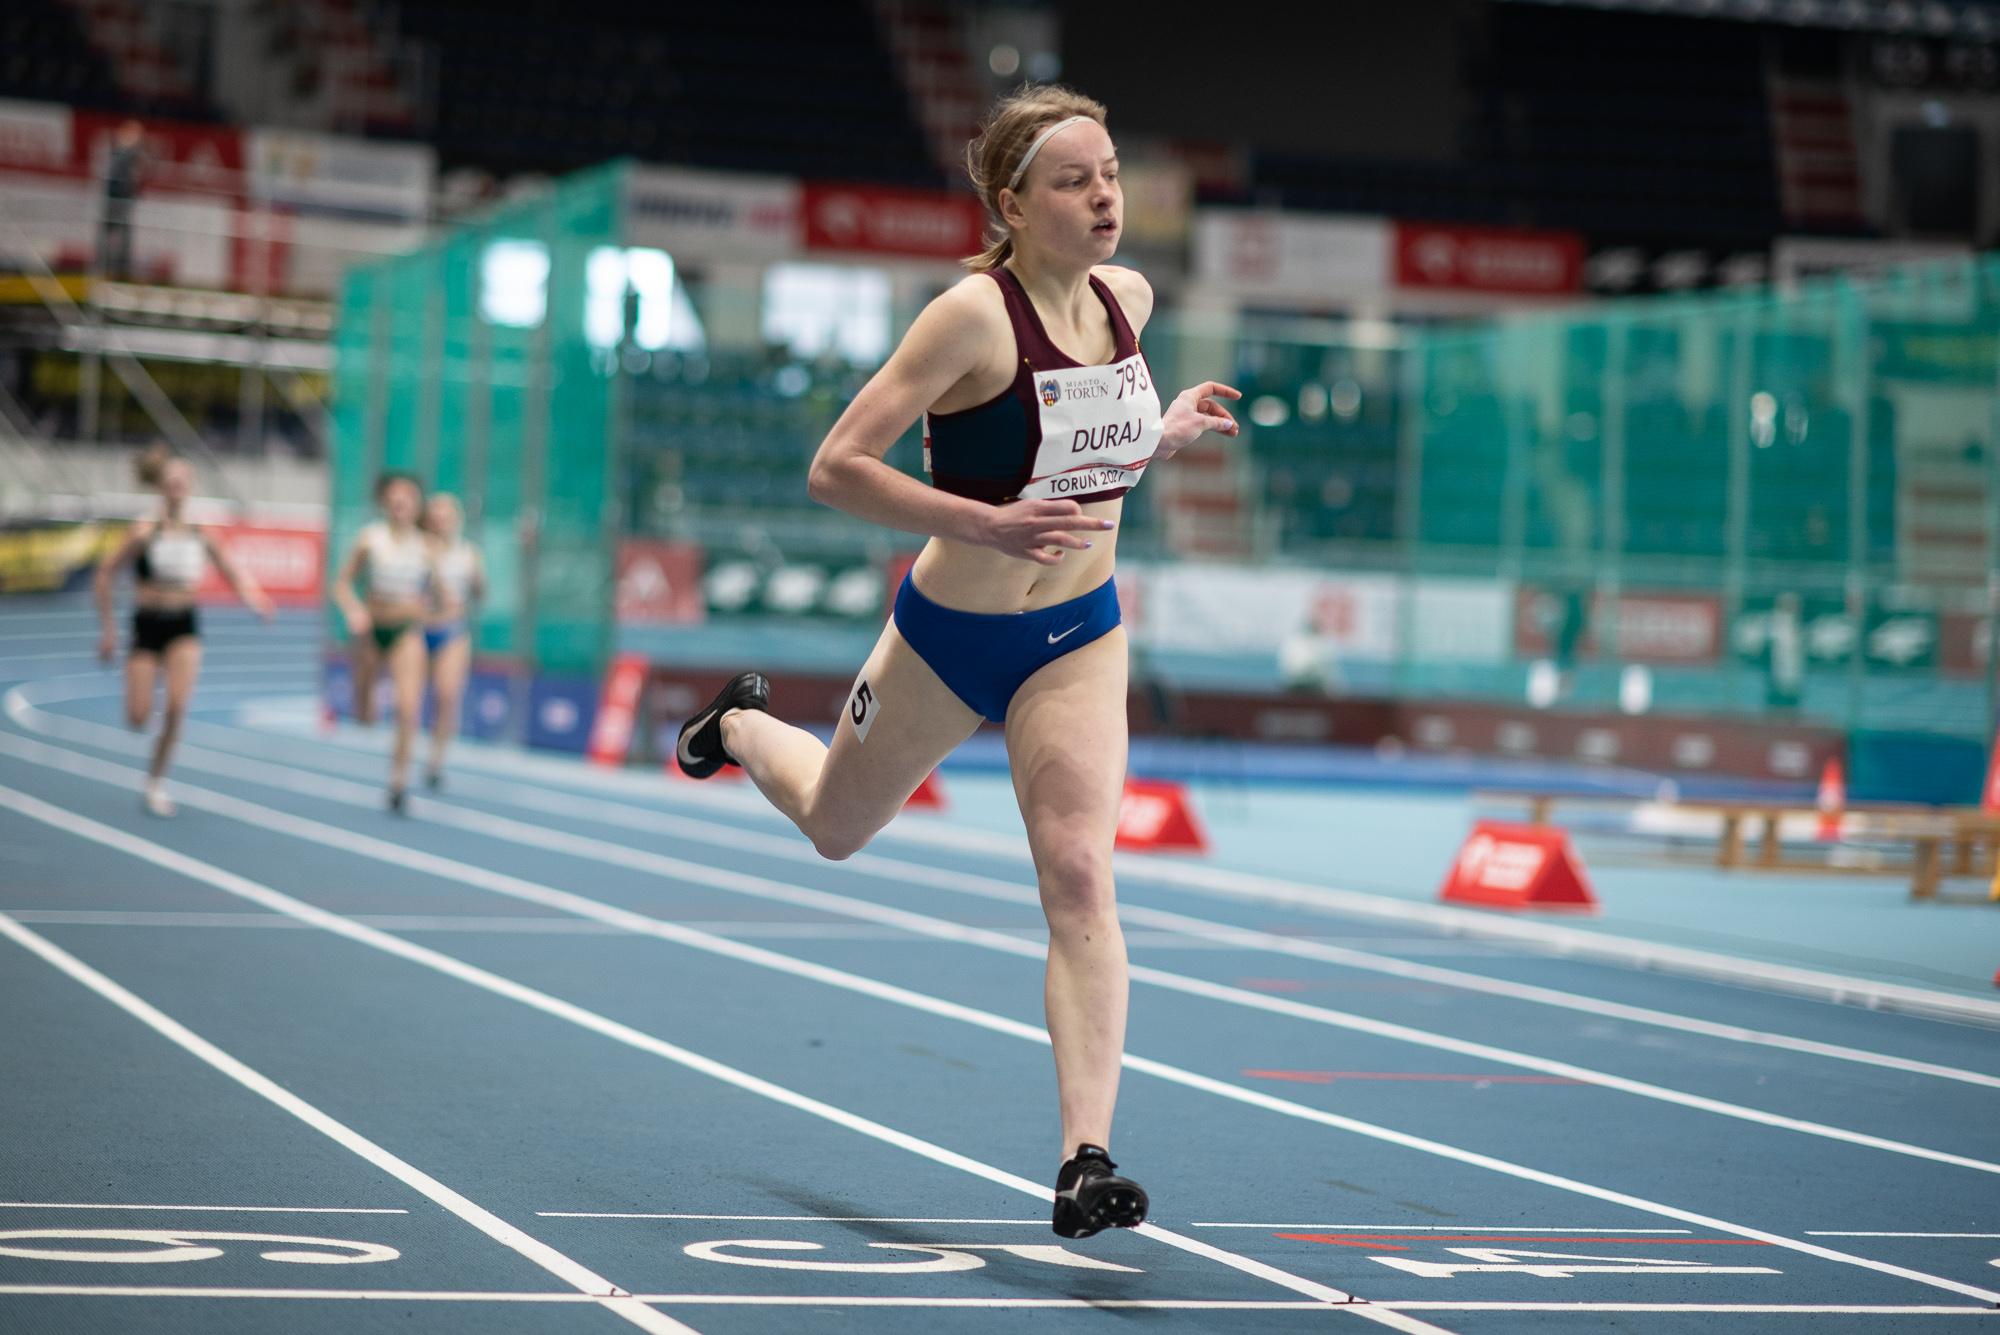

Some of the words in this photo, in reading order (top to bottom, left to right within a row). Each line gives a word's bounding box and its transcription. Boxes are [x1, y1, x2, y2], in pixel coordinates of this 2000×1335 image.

[1064, 382, 1109, 401] TORUŃ
[1066, 378, 1100, 388] MIASTO
[1116, 360, 1148, 400] 793
[1071, 417, 1142, 454] DURAJ
[1050, 469, 1098, 493] TORUŃ
[851, 680, 873, 726] 5
